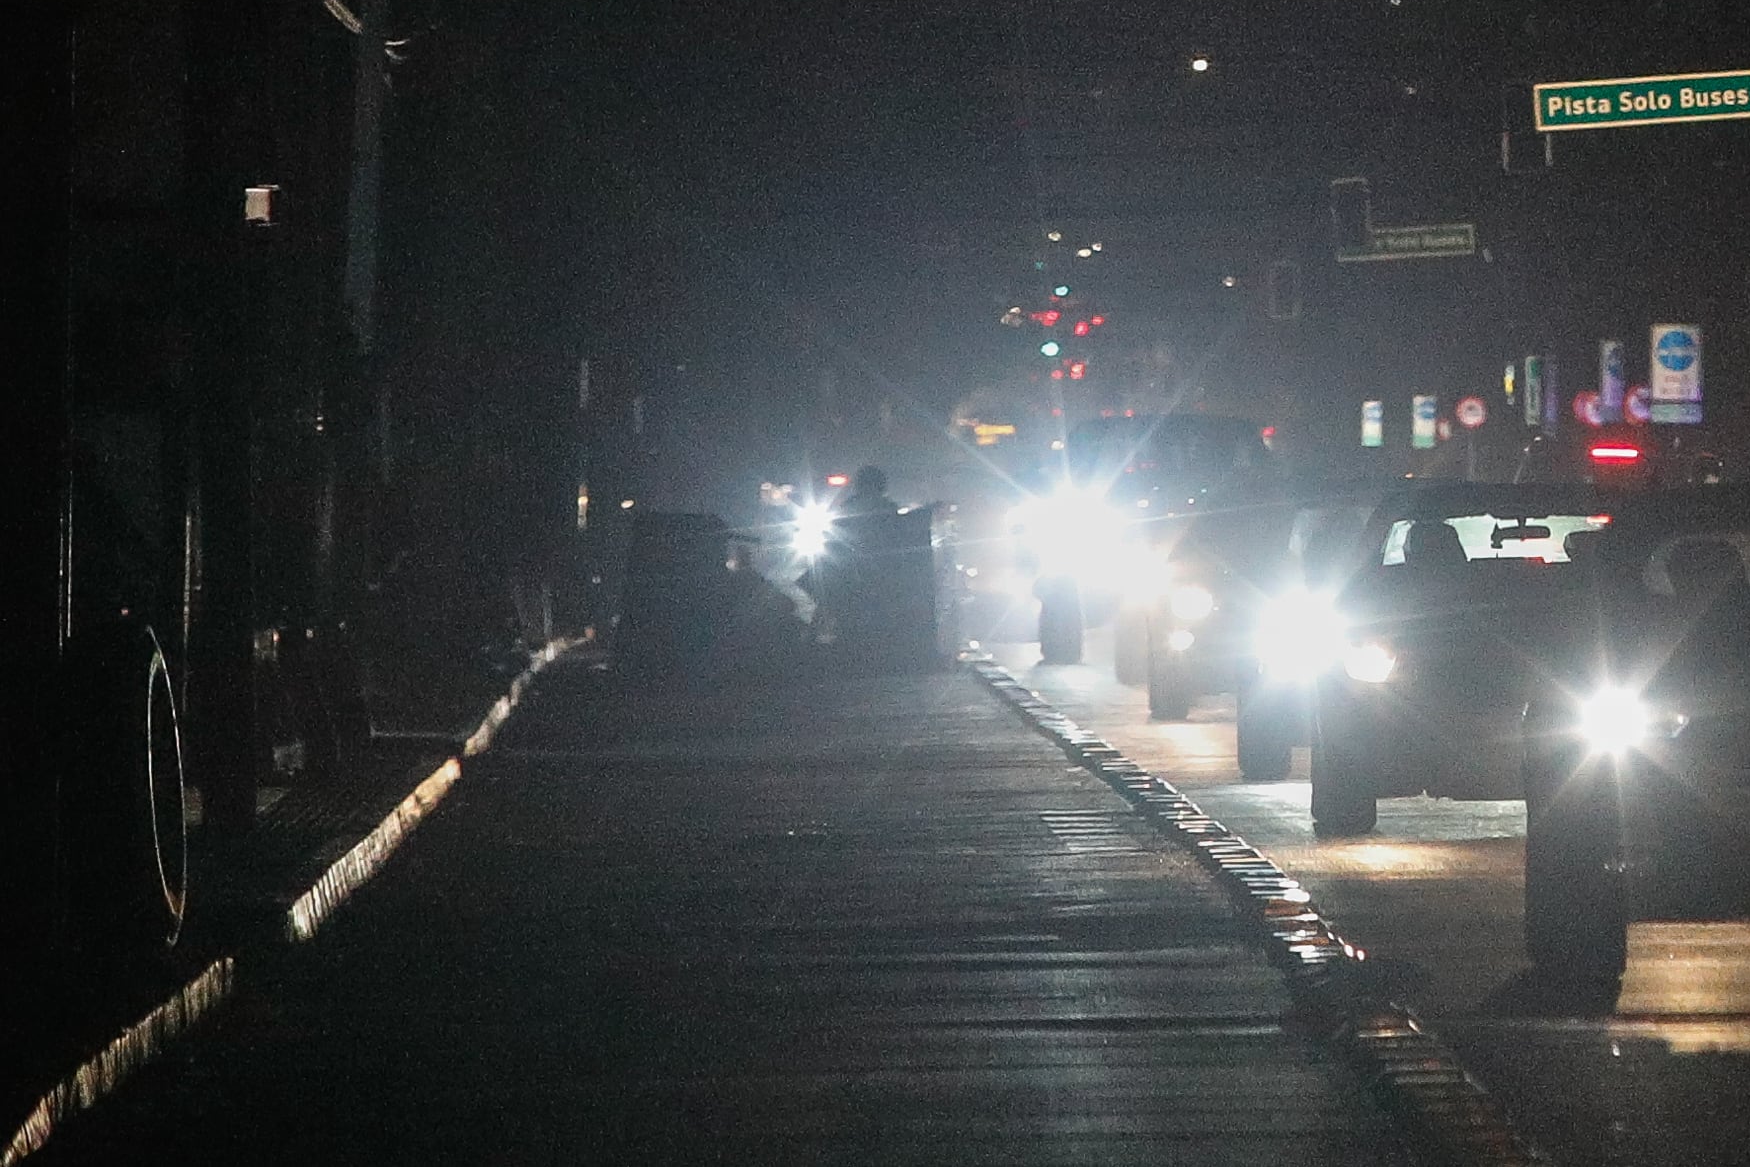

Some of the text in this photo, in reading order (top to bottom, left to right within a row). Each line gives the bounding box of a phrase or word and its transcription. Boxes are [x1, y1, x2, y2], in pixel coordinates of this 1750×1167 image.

[1547, 87, 1749, 118] Pista Solo Buses
